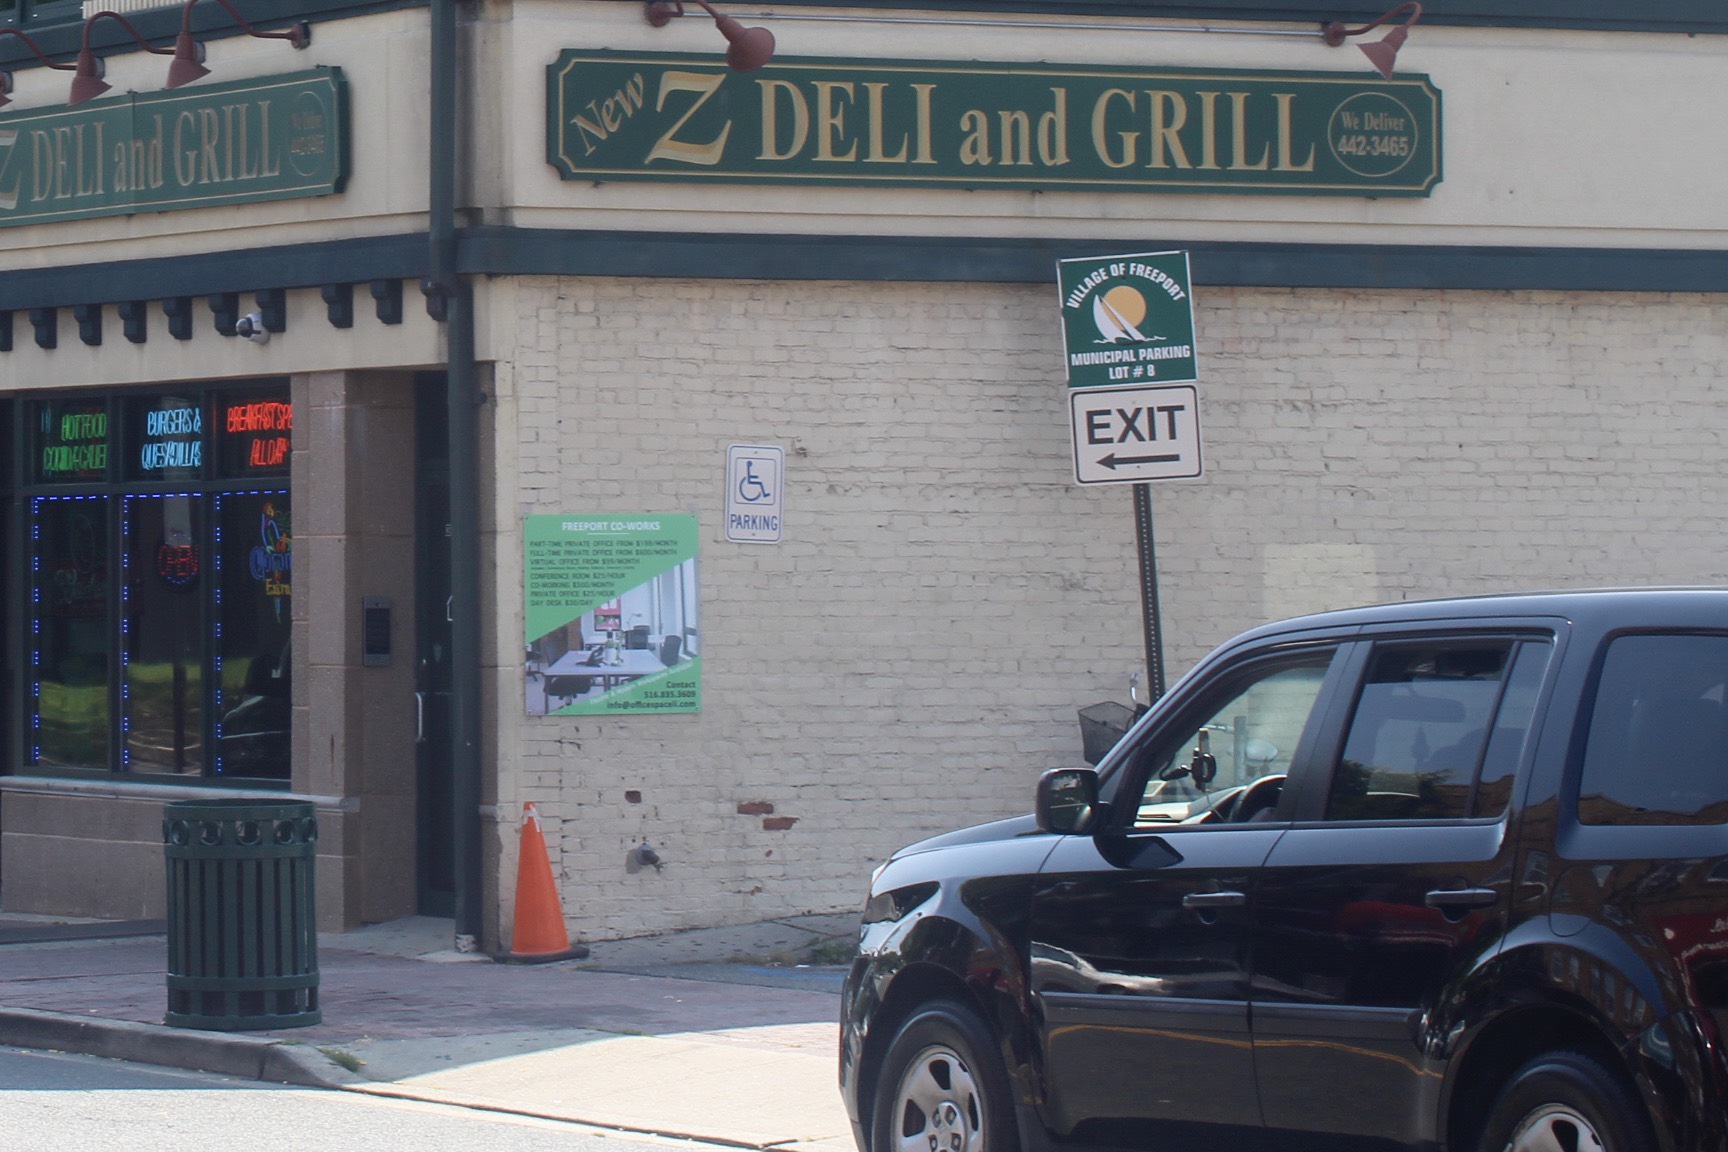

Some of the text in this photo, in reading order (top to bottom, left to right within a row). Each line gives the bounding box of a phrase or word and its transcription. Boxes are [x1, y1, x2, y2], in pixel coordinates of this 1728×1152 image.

[570, 70, 1316, 172] New Z DELI and GRILL
[1341, 110, 1405, 131] We Deliver
[29, 121, 106, 202] DELI
[113, 114, 164, 193] and
[174, 100, 281, 187] GRILL
[1337, 134, 1409, 157] 442-3465
[1066, 263, 1186, 309] VILLAGE OF FREEPORT
[1071, 344, 1191, 366] MUNICIPAL PARKING
[1108, 364, 1155, 379] LOT # 8
[147, 408, 192, 436] BURGERS
[227, 402, 278, 433] BREAKFAST
[1086, 405, 1185, 445] EXIT
[250, 439, 267, 467] ALL
[562, 521, 661, 531] FREEPORT CO-WORKS
[730, 513, 778, 531] PARKING
[666, 681, 696, 689] Contact
